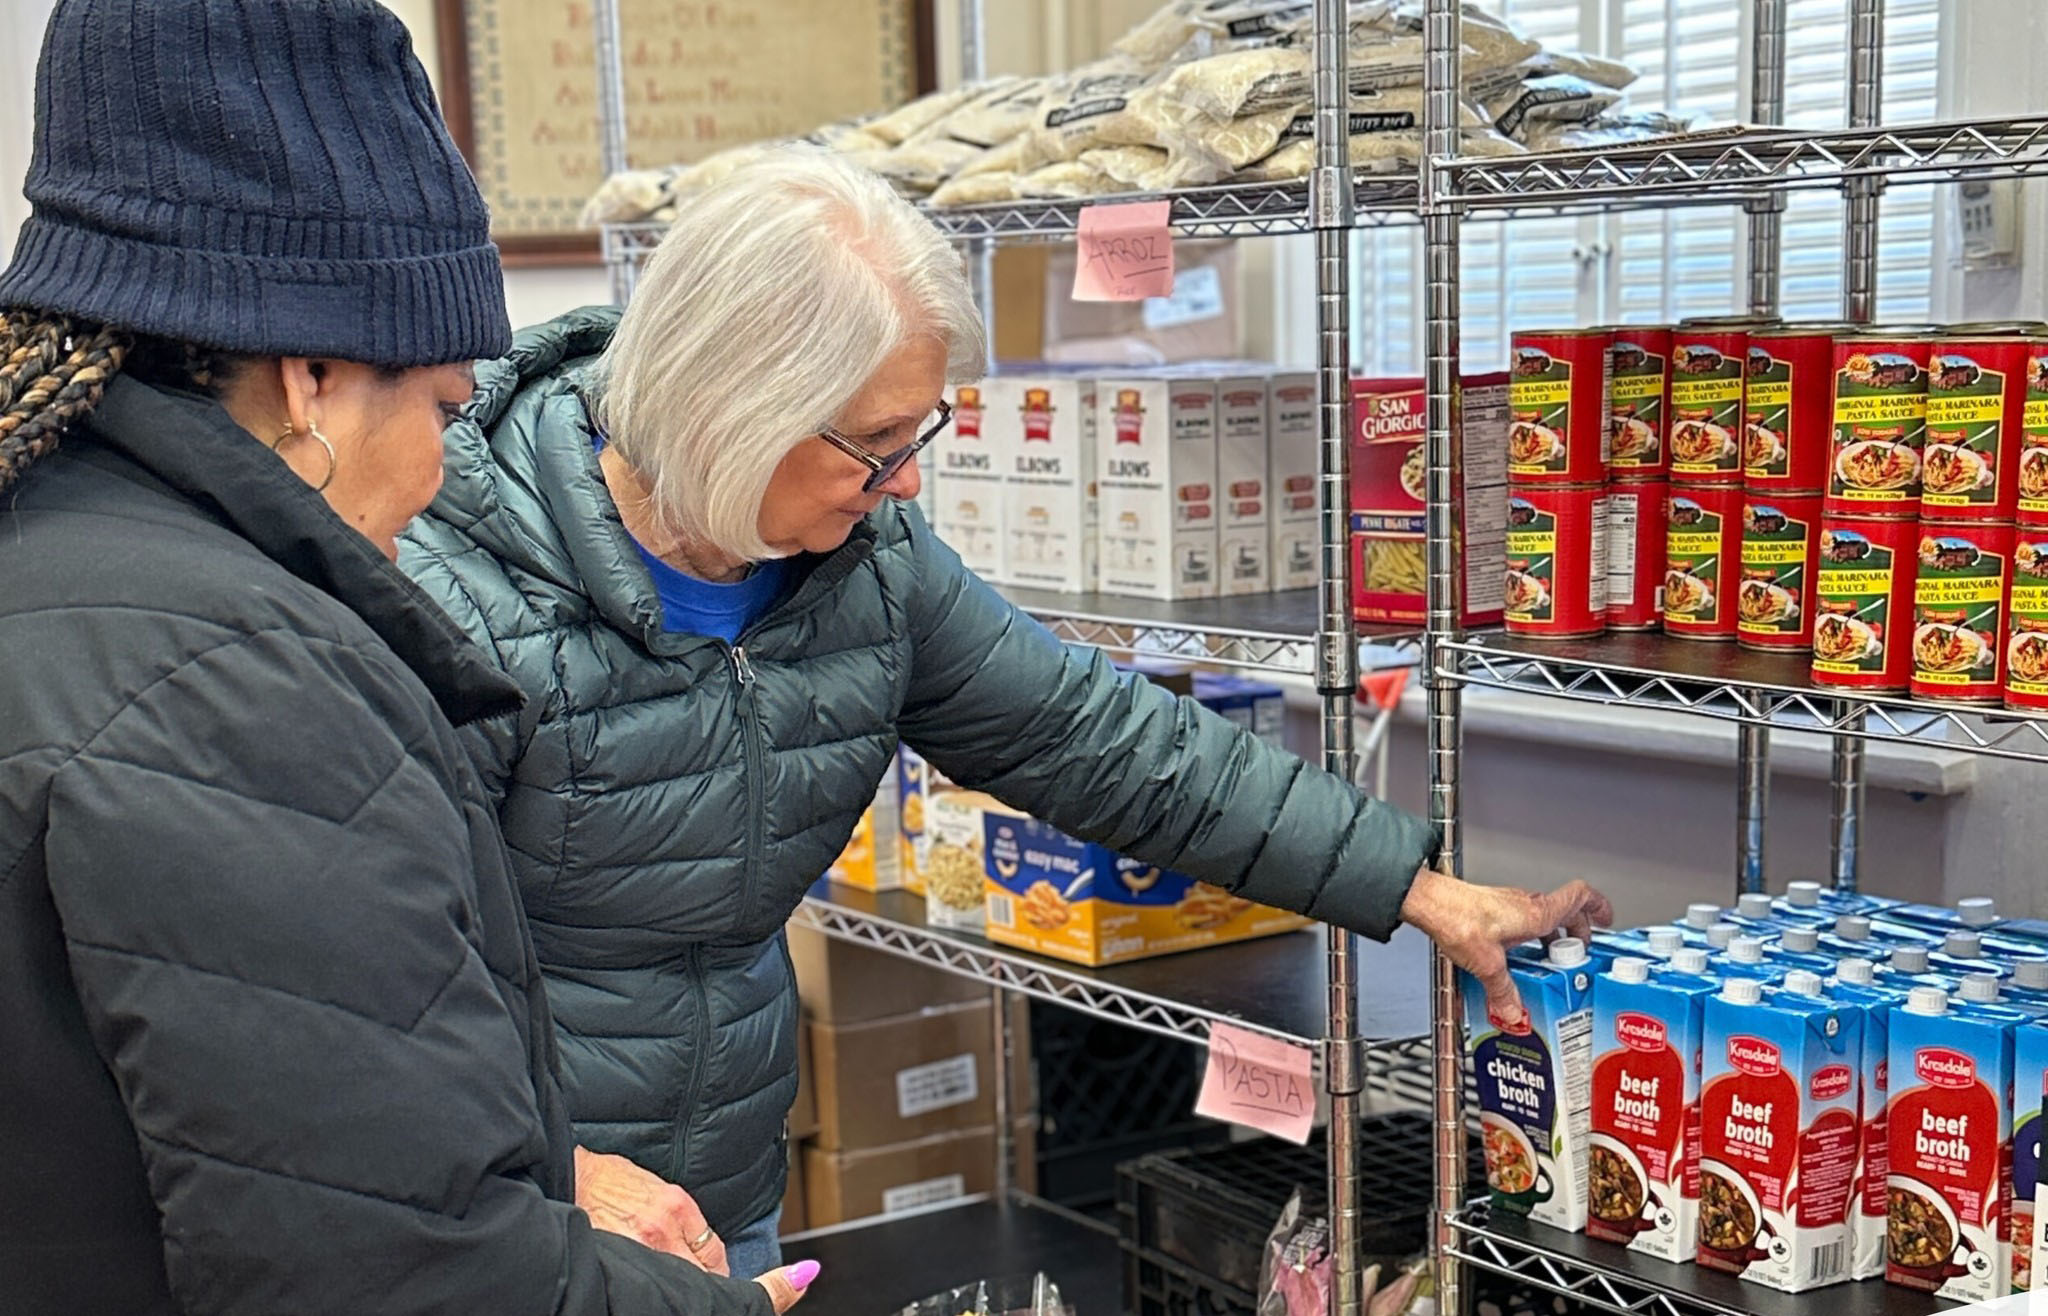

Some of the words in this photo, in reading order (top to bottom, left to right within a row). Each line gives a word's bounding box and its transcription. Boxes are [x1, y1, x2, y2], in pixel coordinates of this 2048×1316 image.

[1085, 226, 1168, 280] ARROZ
[1523, 383, 1569, 393] MARINARA
[1615, 375, 1661, 386] MARINARA
[1693, 381, 1740, 390] MARINARA
[1524, 394, 1550, 402] SAUCE
[1616, 388, 1645, 396] SAUCE
[1694, 391, 1722, 400] SAUCE
[1879, 395, 1927, 407] MARINAR
[1379, 398, 1410, 417] SAN
[1945, 398, 2000, 409] MARINARA
[1846, 408, 1877, 420] PASTA
[1880, 408, 1915, 419] SAUCE
[1945, 410, 1978, 420] SAUCE
[946, 451, 991, 471] ELBOWS
[1015, 455, 1061, 475] ELBOWS
[1107, 459, 1150, 478] ELBOWS
[1676, 535, 1719, 543] MARINARA
[1757, 542, 1804, 551] MARINARA
[1677, 545, 1702, 553] SAUCE
[1758, 553, 1786, 562] SAUCE
[1836, 572, 1889, 582] MARINARA
[1943, 579, 2000, 590] MARINARA
[1836, 583, 1869, 592] SAUCE
[1943, 591, 1980, 601] SAUCE
[1023, 849, 1052, 873] easy
[1052, 855, 1080, 874] mac
[1618, 1018, 1663, 1041] Krasdale
[1729, 1040, 1777, 1065] Krasdale
[1217, 1034, 1304, 1111] PASTA
[1487, 1057, 1546, 1091] chicken
[1918, 1053, 1971, 1077] Krasdale
[1620, 1069, 1660, 1098] beef
[1811, 1071, 1848, 1089] Krasdale
[1498, 1078, 1539, 1109] broth
[1614, 1090, 1660, 1122] broth
[1731, 1093, 1773, 1124] beef
[1922, 1107, 1968, 1137] beef
[1724, 1115, 1774, 1149] broth
[1915, 1129, 1970, 1162] broth
